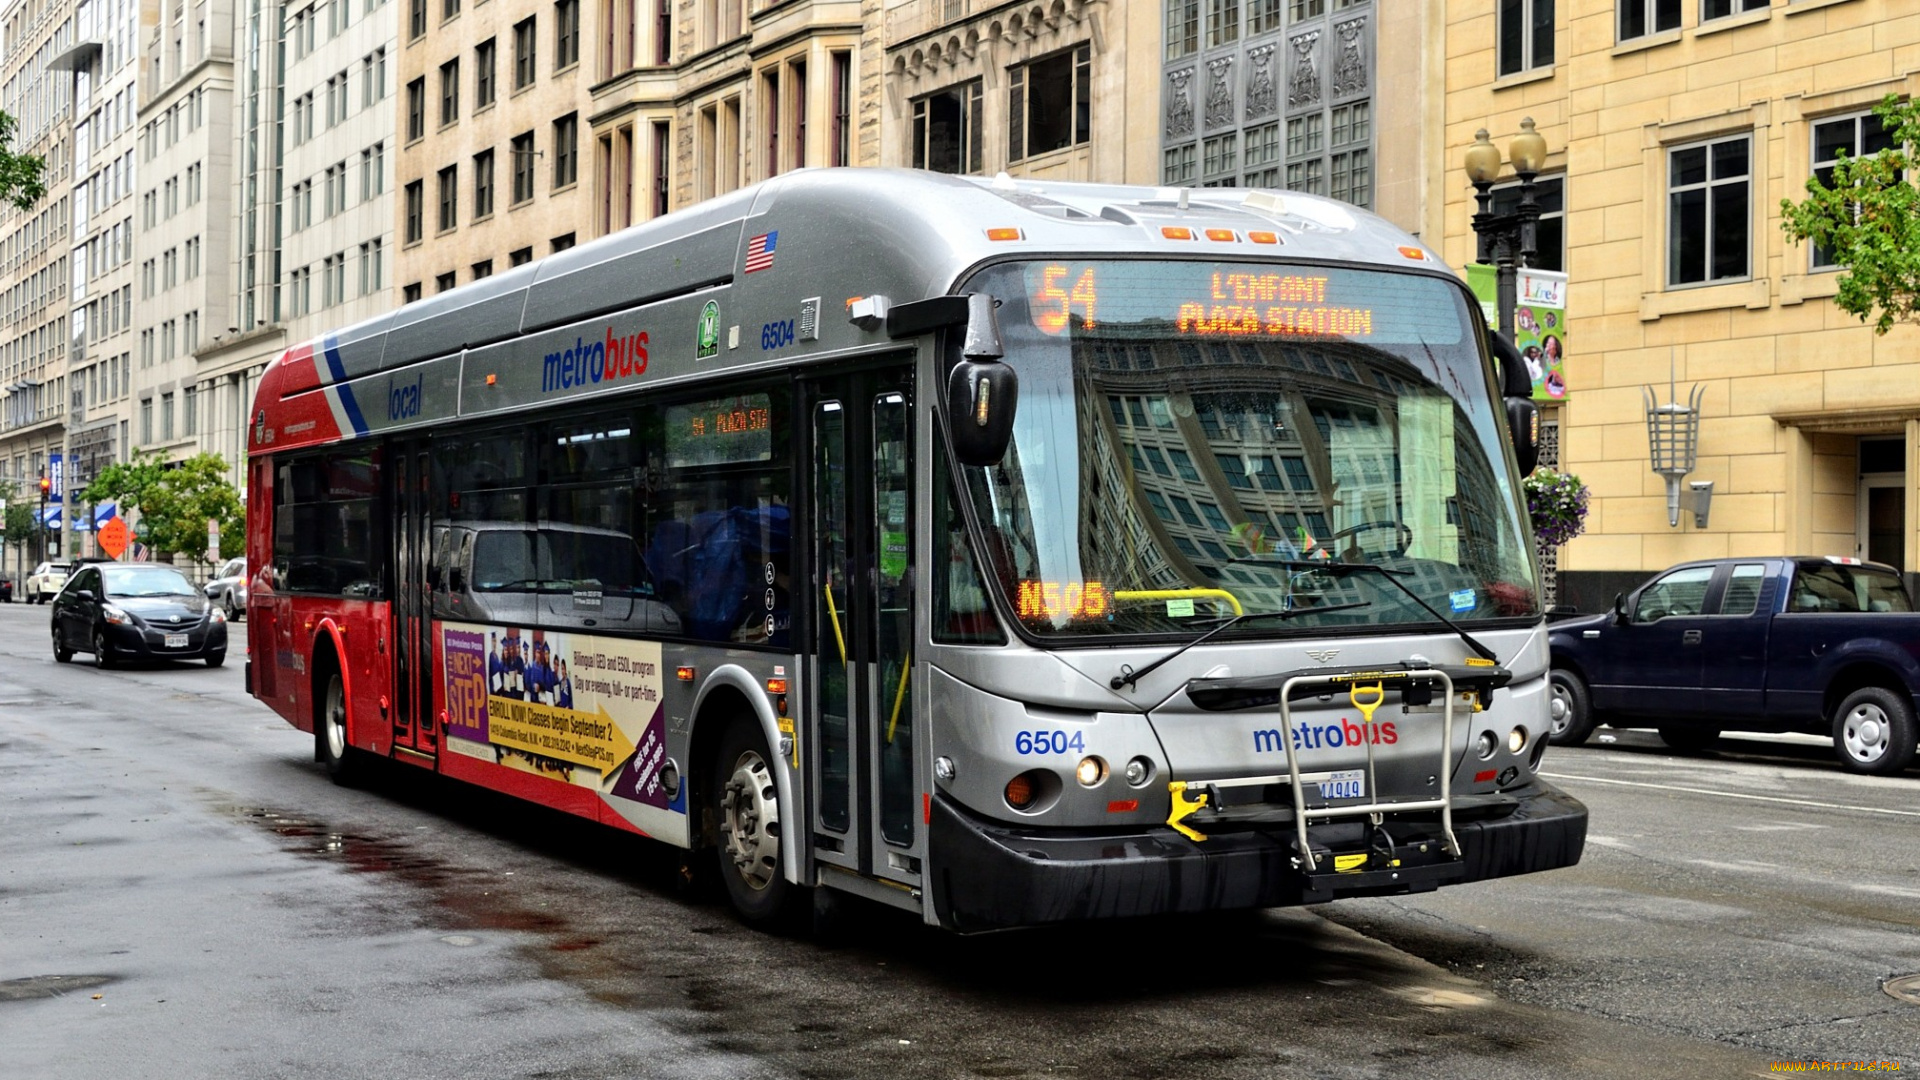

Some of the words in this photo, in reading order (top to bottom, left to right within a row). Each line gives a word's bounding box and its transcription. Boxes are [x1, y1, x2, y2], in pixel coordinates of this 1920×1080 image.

[1044, 264, 1096, 330] 54
[1211, 272, 1328, 302] L'ENFANT
[761, 319, 795, 351] 6504
[1179, 303, 1260, 333] PLAZA
[1266, 307, 1373, 335] STATION
[542, 326, 649, 392] metrobus
[388, 372, 422, 421] local
[693, 417, 705, 436] 54
[717, 411, 747, 433] PLAZA
[1018, 580, 1107, 616] N505
[453, 652, 473, 676] NEXT
[573, 651, 595, 670] Bilingual
[607, 656, 616, 671] and
[617, 656, 631, 673] ESOL
[449, 673, 486, 729] STEP
[574, 675, 584, 693] Day
[585, 679, 591, 691] or
[591, 679, 612, 698] evening,
[612, 680, 624, 696] full-
[624, 684, 630, 697] or
[631, 684, 657, 702] part-time
[490, 700, 510, 720] ENROLL
[511, 704, 527, 724] NOW!
[528, 707, 550, 729] Classes
[551, 711, 569, 735] begin
[571, 715, 606, 740] September
[607, 722, 613, 741] 2
[1253, 718, 1398, 753] metrobus
[1015, 730, 1085, 755] 6504
[646, 771, 660, 797] 16-24
